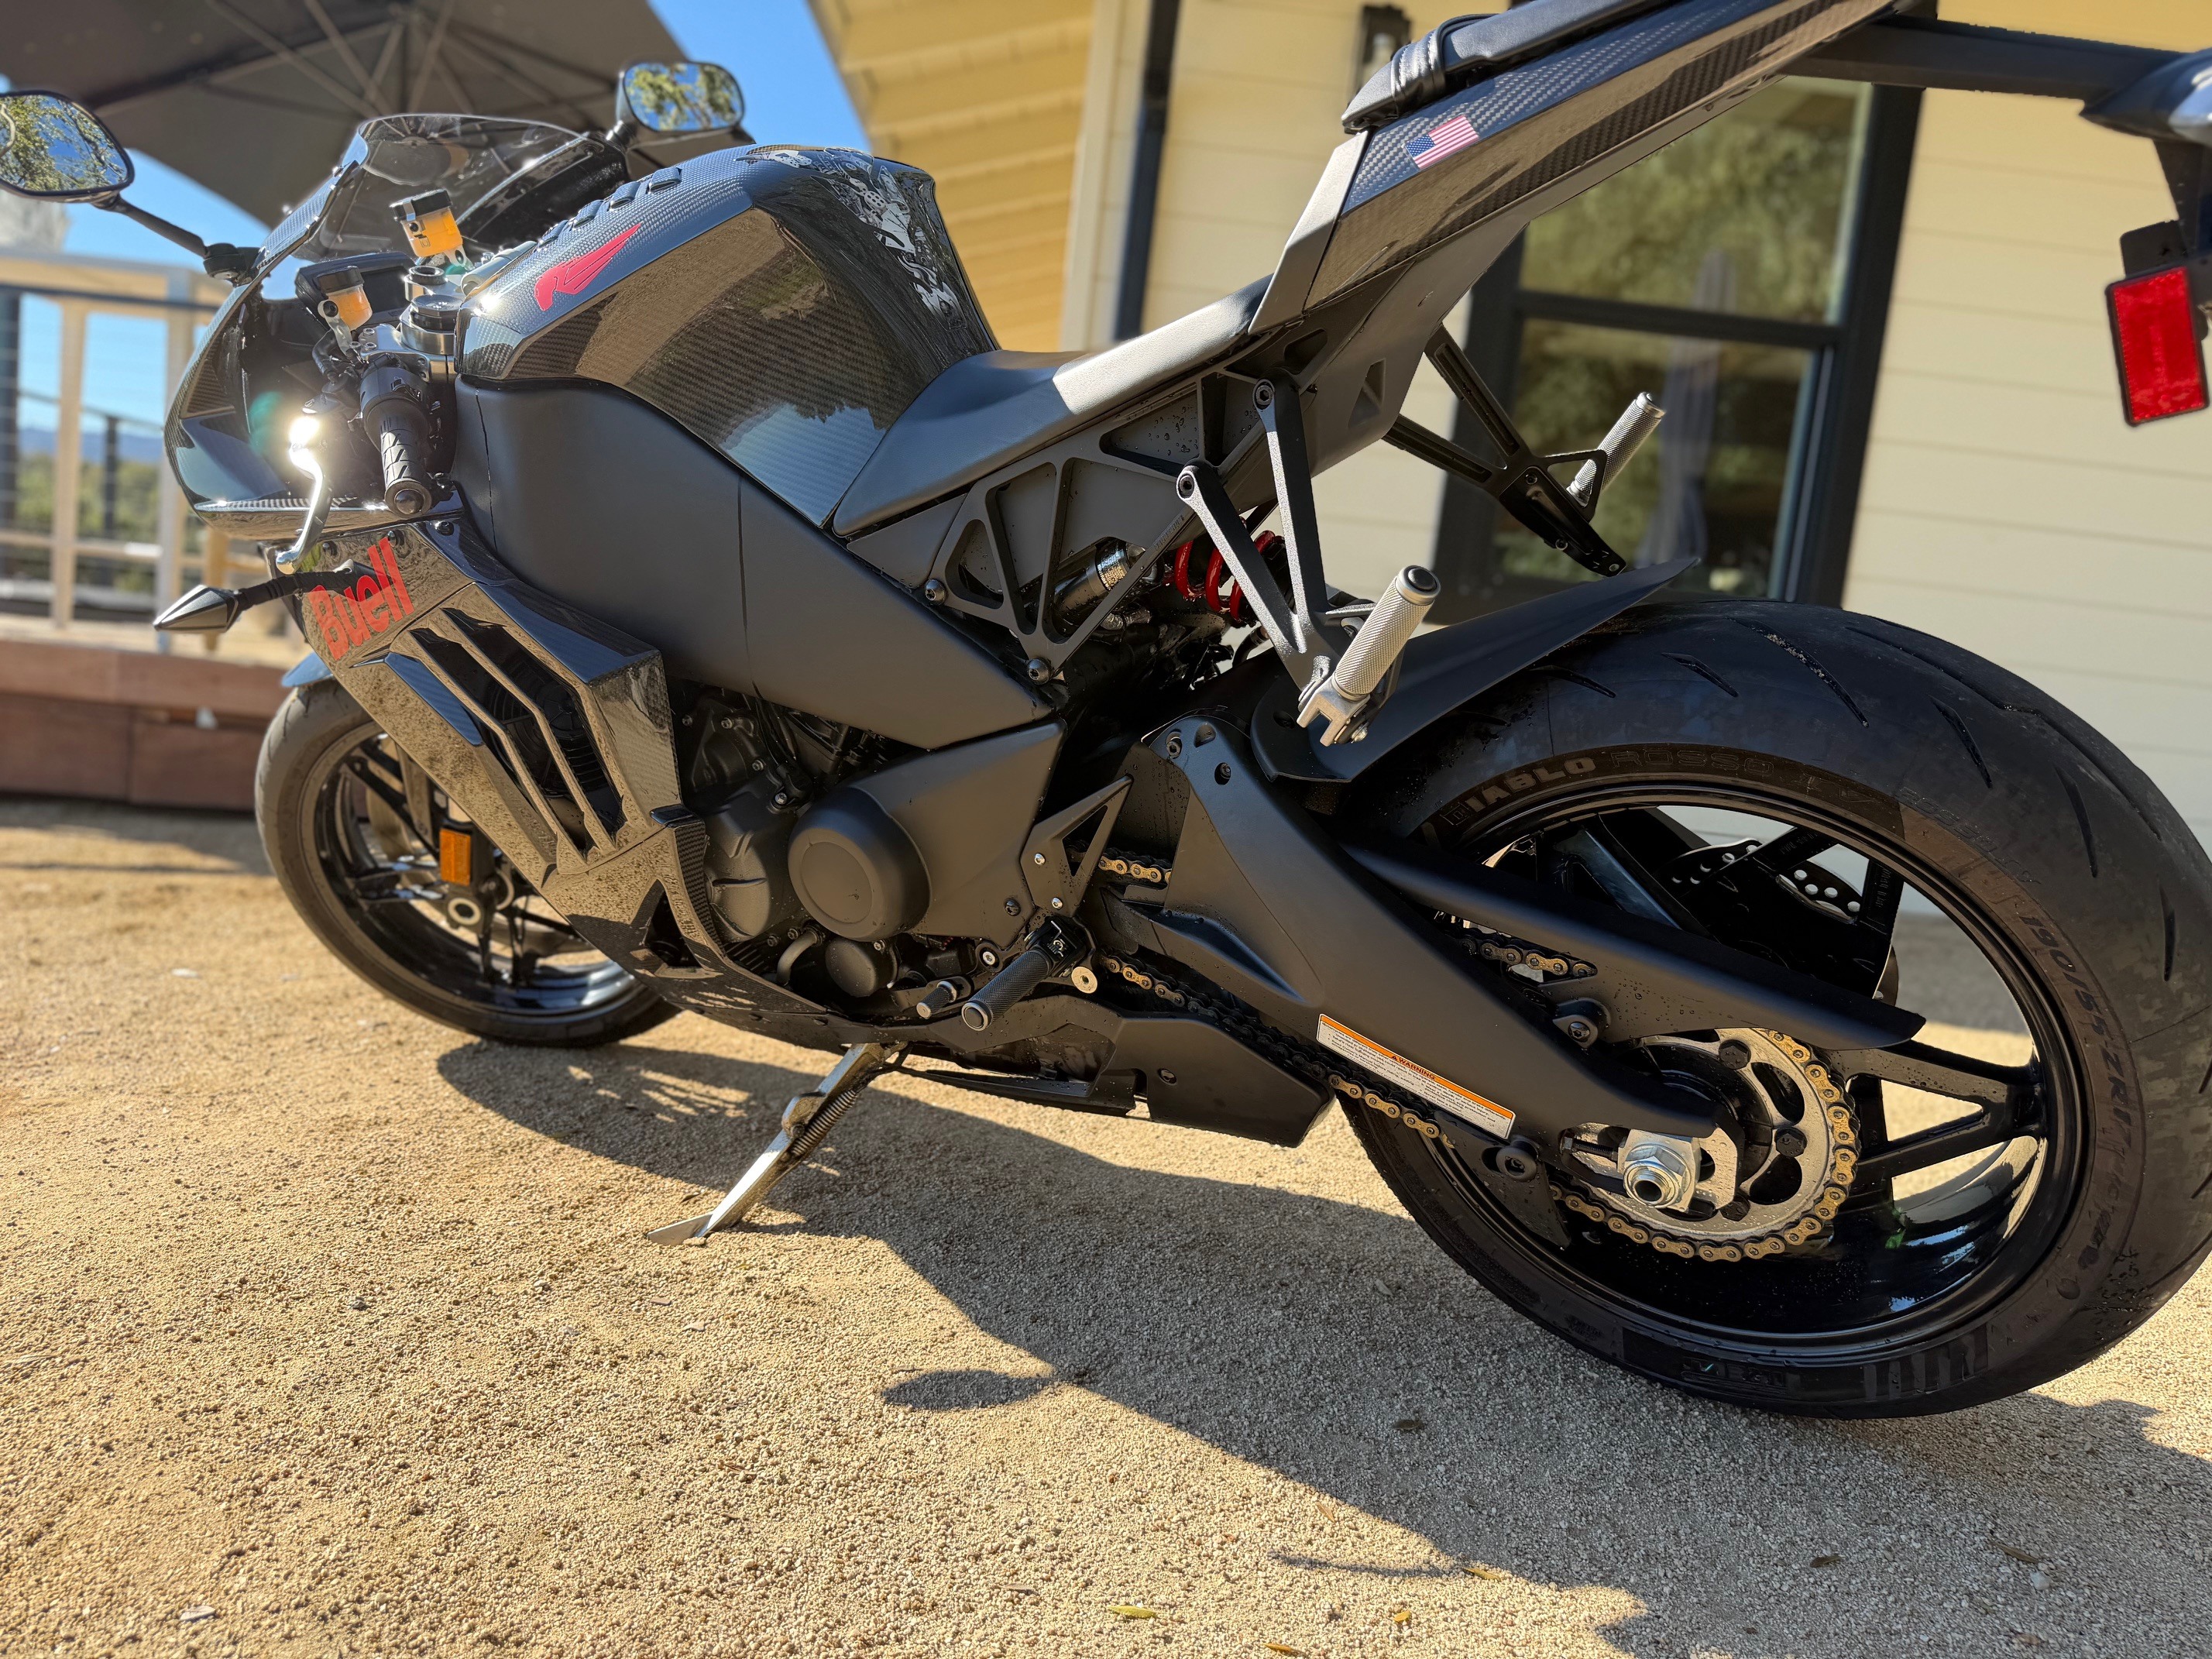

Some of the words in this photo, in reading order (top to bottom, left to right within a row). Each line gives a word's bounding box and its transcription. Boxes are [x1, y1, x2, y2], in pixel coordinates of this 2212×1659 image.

[307, 537, 414, 661] Buell
[1439, 757, 1596, 826] DIABLO
[1399, 1057, 1435, 1080] WARNING
